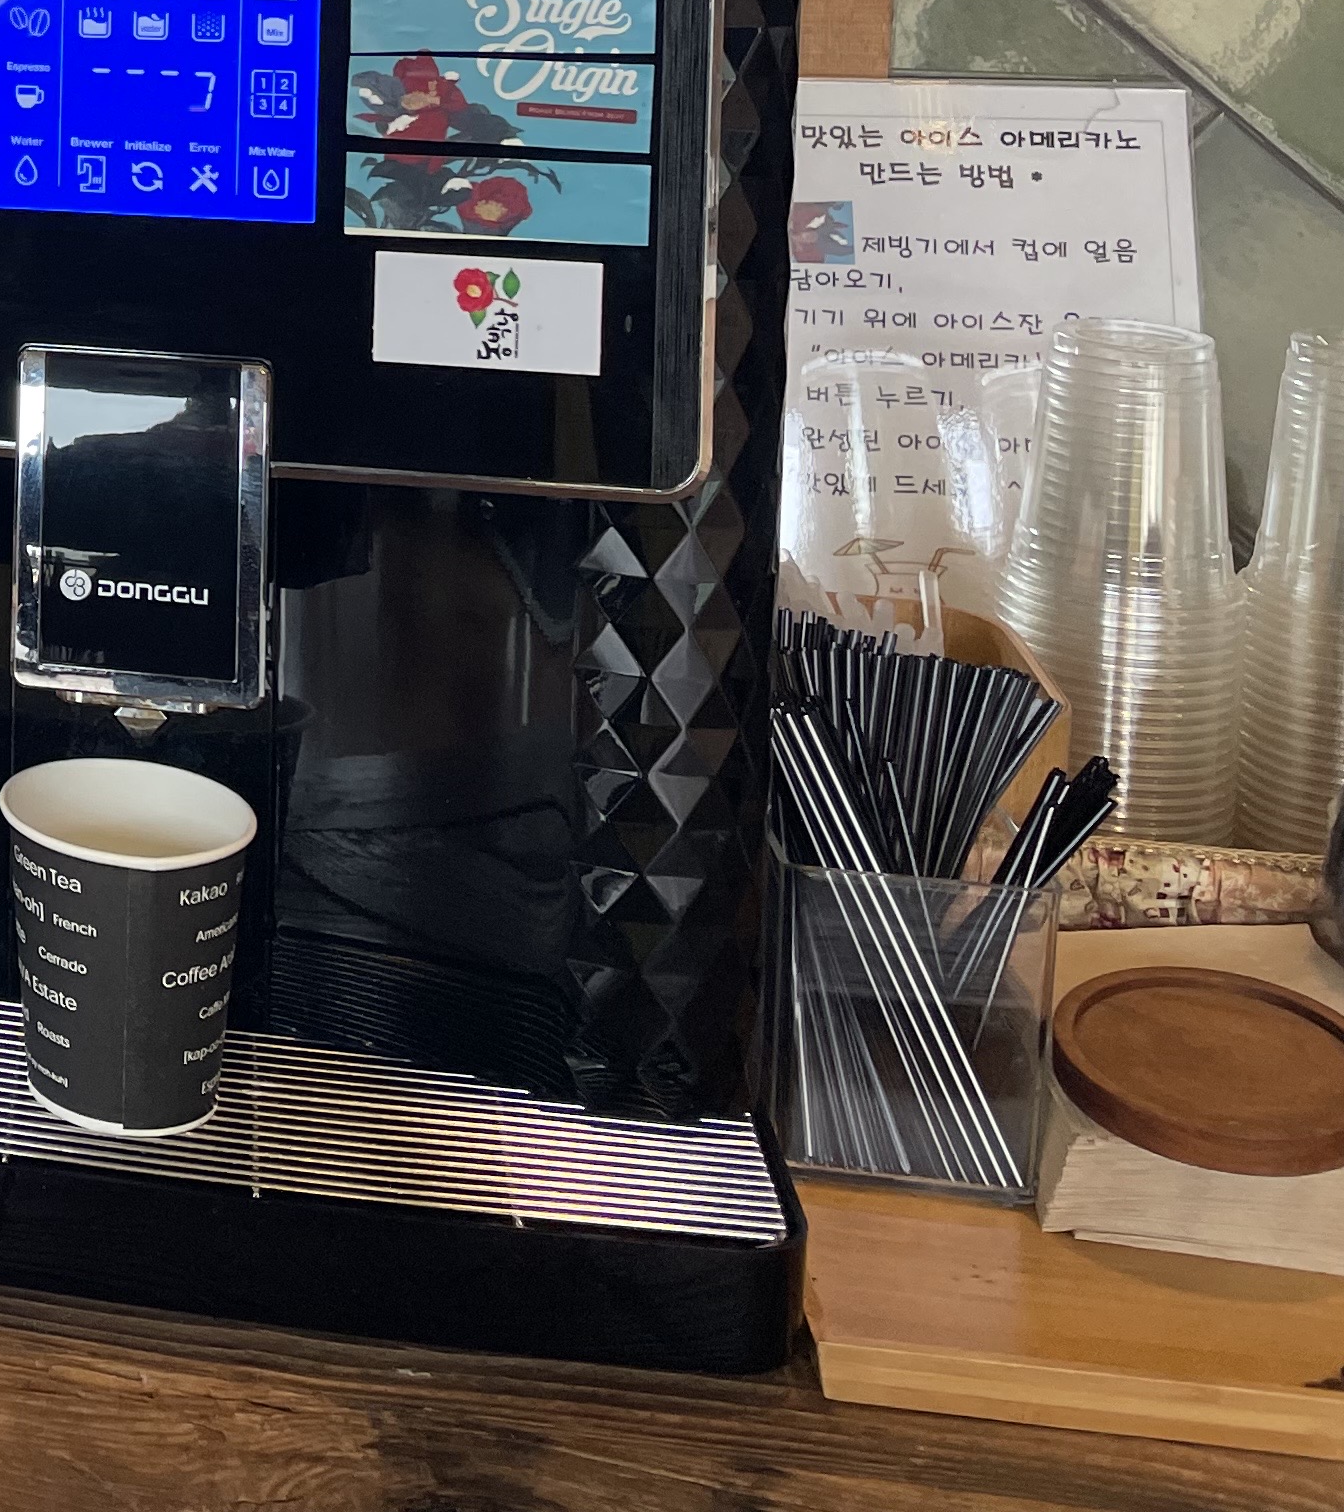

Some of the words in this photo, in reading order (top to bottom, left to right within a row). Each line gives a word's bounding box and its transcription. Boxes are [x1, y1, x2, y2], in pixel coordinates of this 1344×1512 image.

[5, 60, 52, 74] Espresso
[476, 28, 640, 104] Origin
[279, 78, 290, 91] 2
[258, 98, 268, 111] 3
[278, 99, 289, 112] 4
[10, 135, 44, 147] Water
[70, 136, 114, 150] Brewer
[124, 139, 173, 153] Initialize
[189, 142, 222, 155] Error
[800, 124, 884, 150] 맛있는
[899, 126, 983, 148] 아이스
[999, 129, 1142, 151] 아메리카노
[859, 160, 943, 187] 만드는
[959, 162, 1015, 190] 방법
[861, 235, 996, 260] 제빙기에서
[1011, 238, 1069, 263] 컵에
[1083, 238, 1138, 265] 얼음
[794, 307, 844, 328] 기기
[862, 307, 918, 329] 위에
[933, 310, 1044, 336] 아이스잔
[97, 579, 209, 606] DONGGU
[13, 844, 47, 882] Green
[48, 867, 82, 894] Tea
[179, 880, 229, 907] Kakao
[52, 912, 99, 939] French
[37, 944, 89, 976] Cerrado
[162, 961, 219, 989] Coffee
[32, 974, 78, 1012] Estate
[36, 1019, 71, 1050] Roasts
